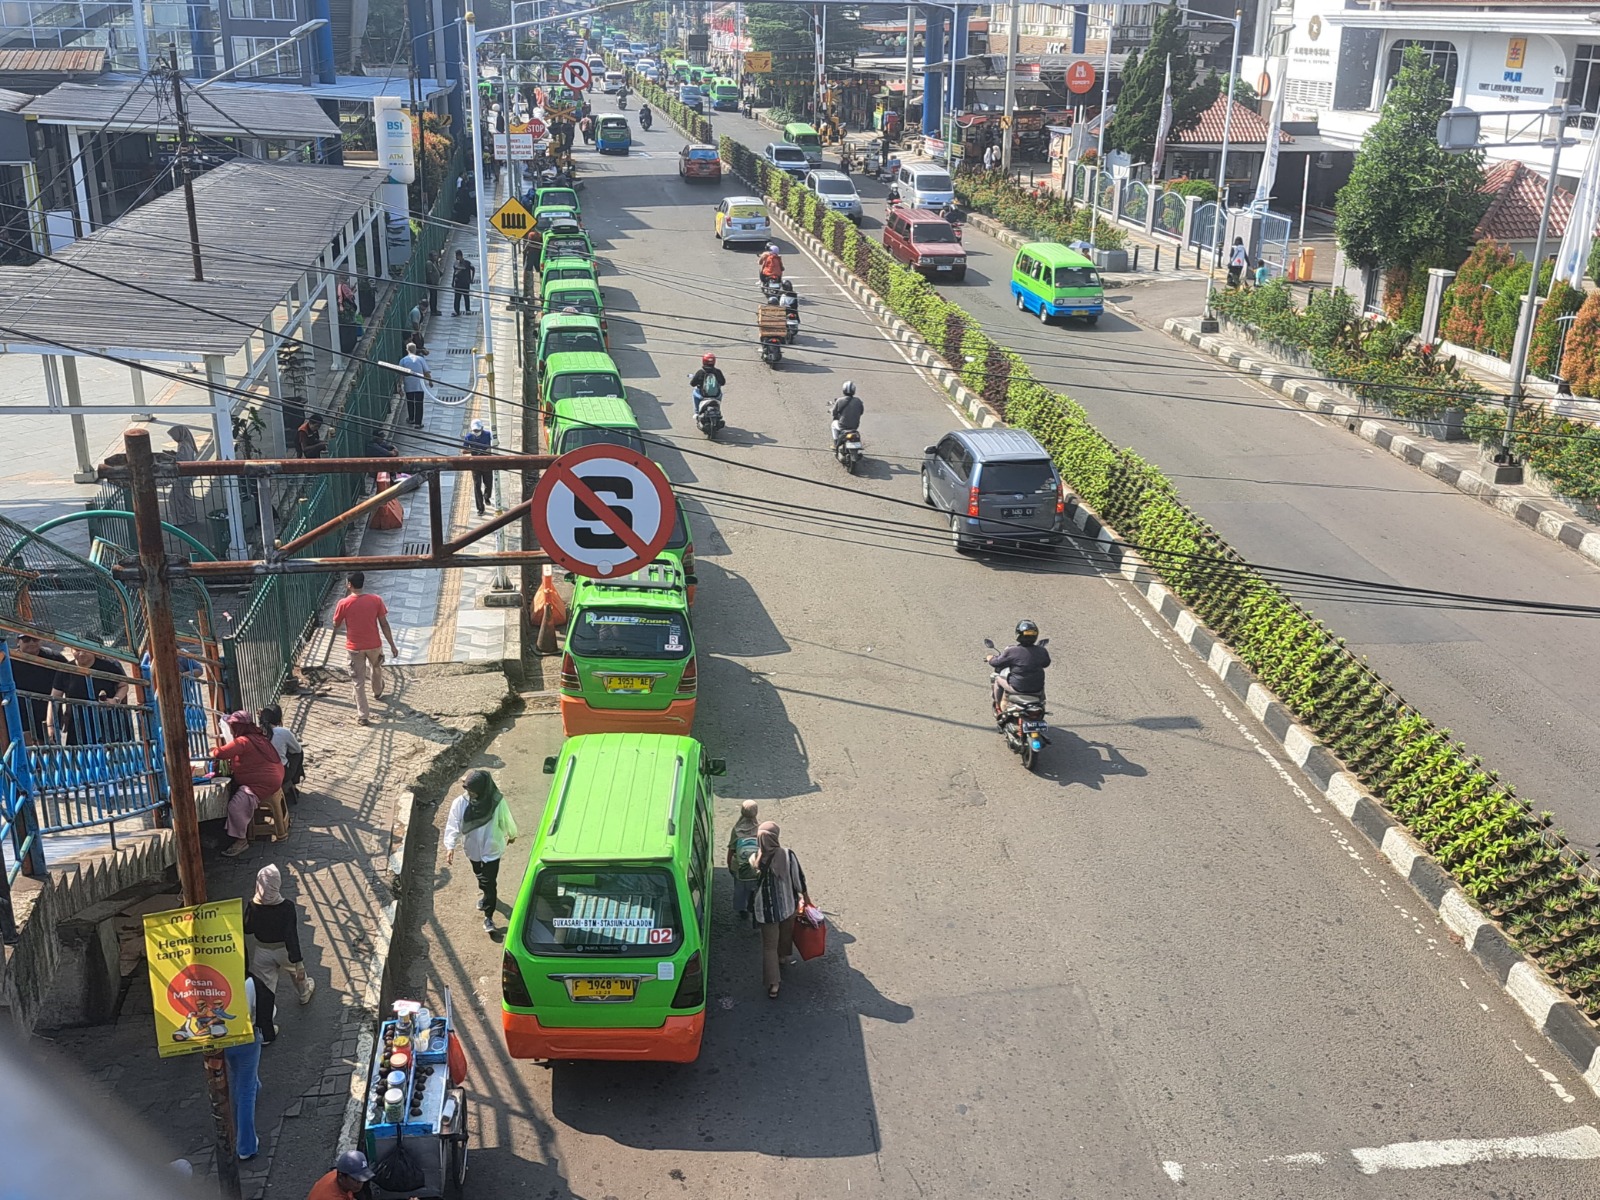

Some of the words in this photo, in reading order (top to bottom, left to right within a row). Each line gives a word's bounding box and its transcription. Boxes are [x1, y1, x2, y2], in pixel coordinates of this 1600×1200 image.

[1046, 42, 1065, 54] KFC
[570, 65, 584, 84] P
[1503, 71, 1522, 82] PLN
[387, 121, 403, 130] BSI
[527, 124, 545, 133] STOP
[574, 475, 633, 549] S
[158, 935, 200, 950] Hemat
[201, 932, 233, 945] terus
[650, 929, 672, 943] 02
[156, 947, 191, 961] tanpa
[194, 943, 236, 958] promo!
[185, 978, 213, 987] Pesan
[575, 981, 580, 990] F
[619, 979, 632, 990] DV
[173, 988, 227, 1000] MaximBike
